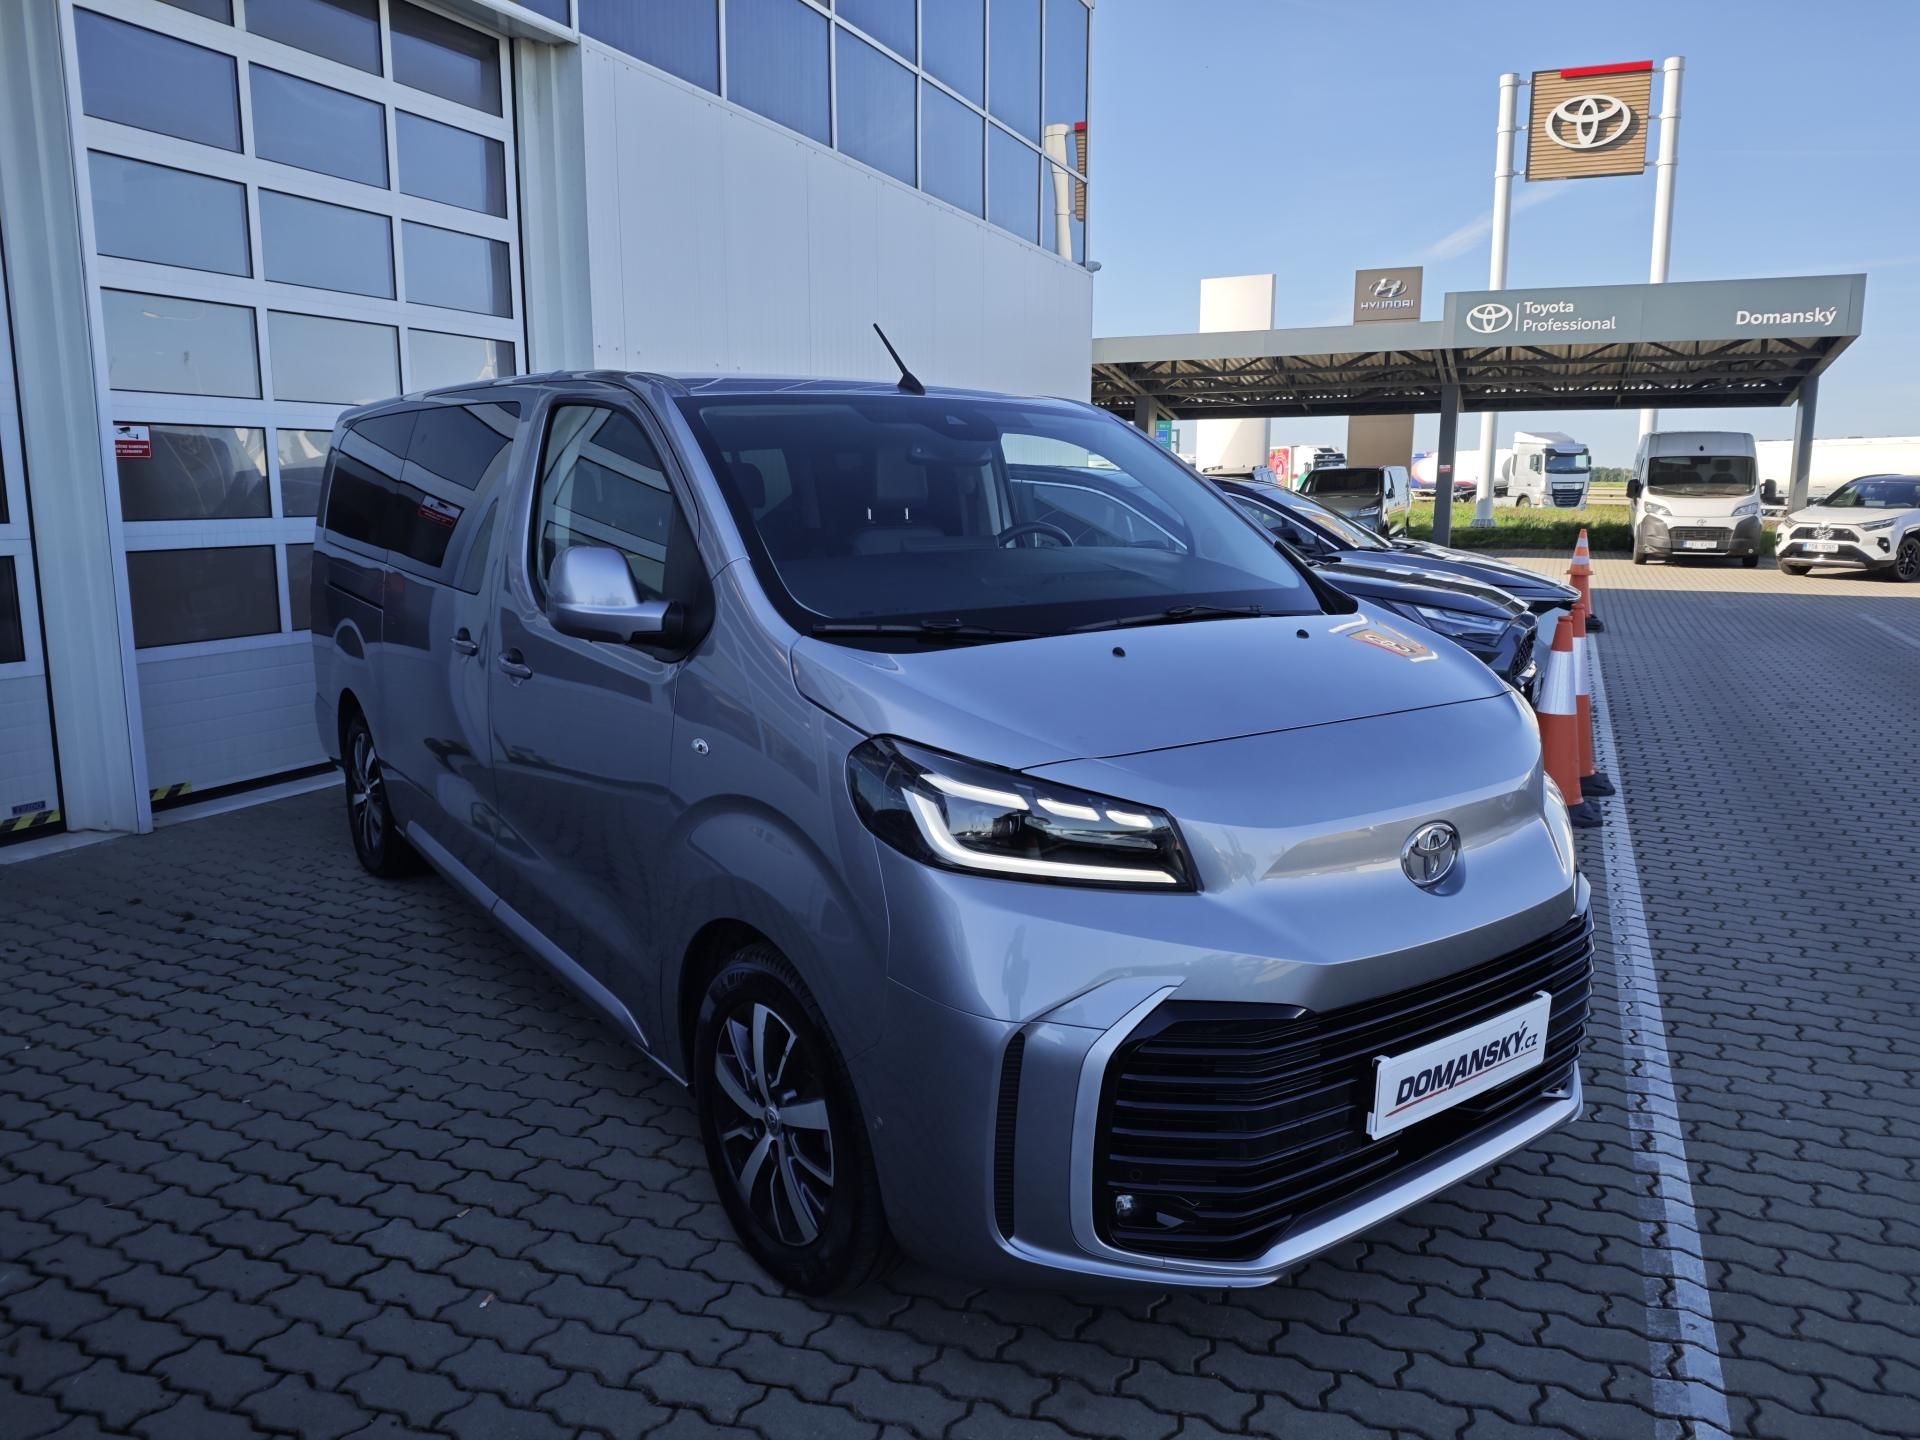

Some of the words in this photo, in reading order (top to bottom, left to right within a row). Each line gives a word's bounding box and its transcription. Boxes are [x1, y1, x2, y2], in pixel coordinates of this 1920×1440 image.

[1360, 299, 1414, 310] HYUNDAI
[1523, 301, 1575, 317] Toyota
[1523, 316, 1617, 332] Professional
[1735, 306, 1838, 326] Domanský
